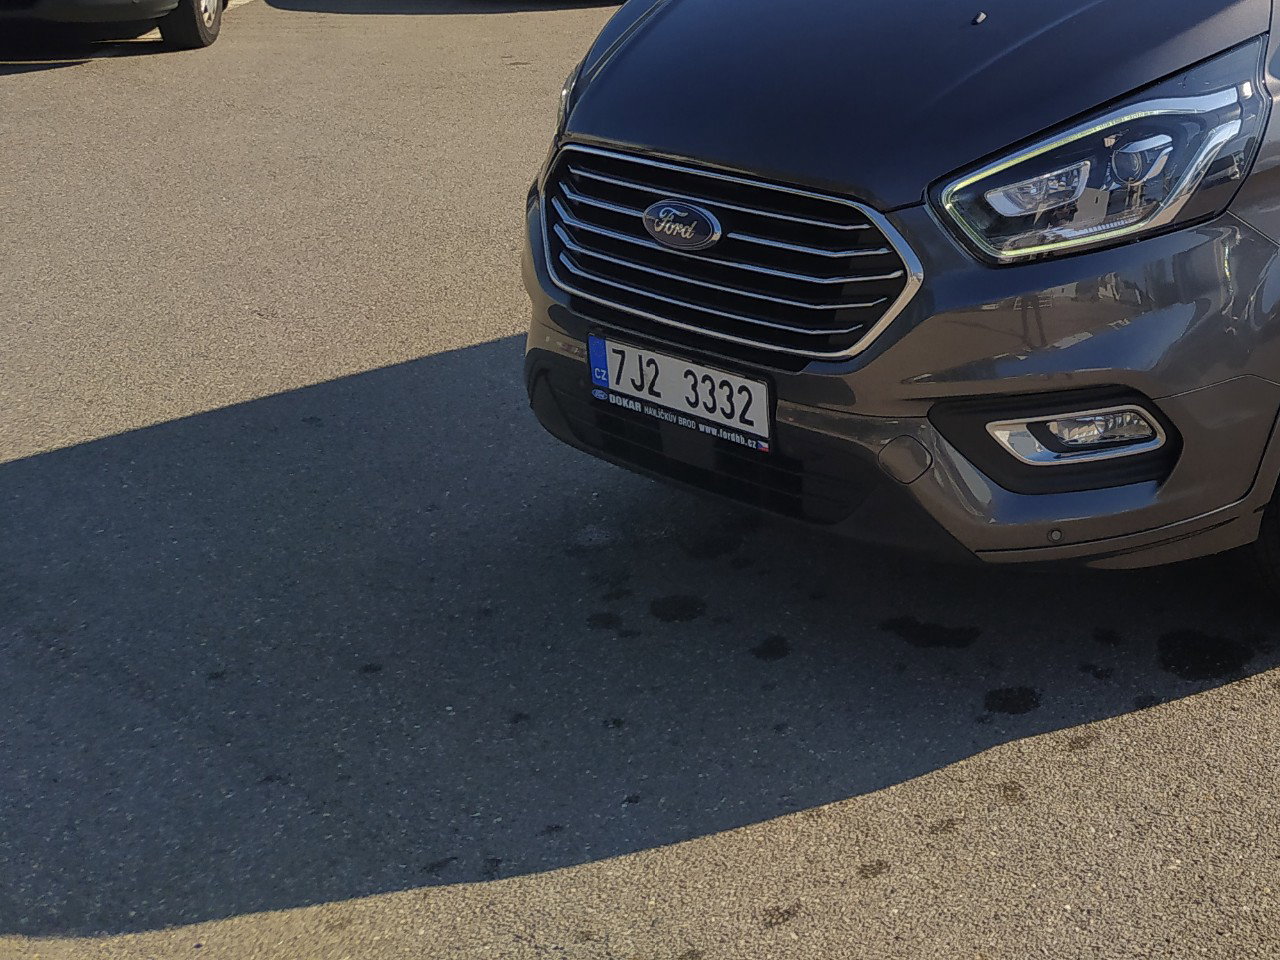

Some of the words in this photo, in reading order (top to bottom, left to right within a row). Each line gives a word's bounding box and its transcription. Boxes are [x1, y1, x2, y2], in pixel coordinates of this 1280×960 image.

[654, 207, 697, 239] Ford
[594, 368, 607, 381] CZ
[612, 348, 661, 398] 7J2
[684, 369, 754, 427] 3332
[609, 394, 641, 412] DOKAR
[678, 416, 696, 430] BROD
